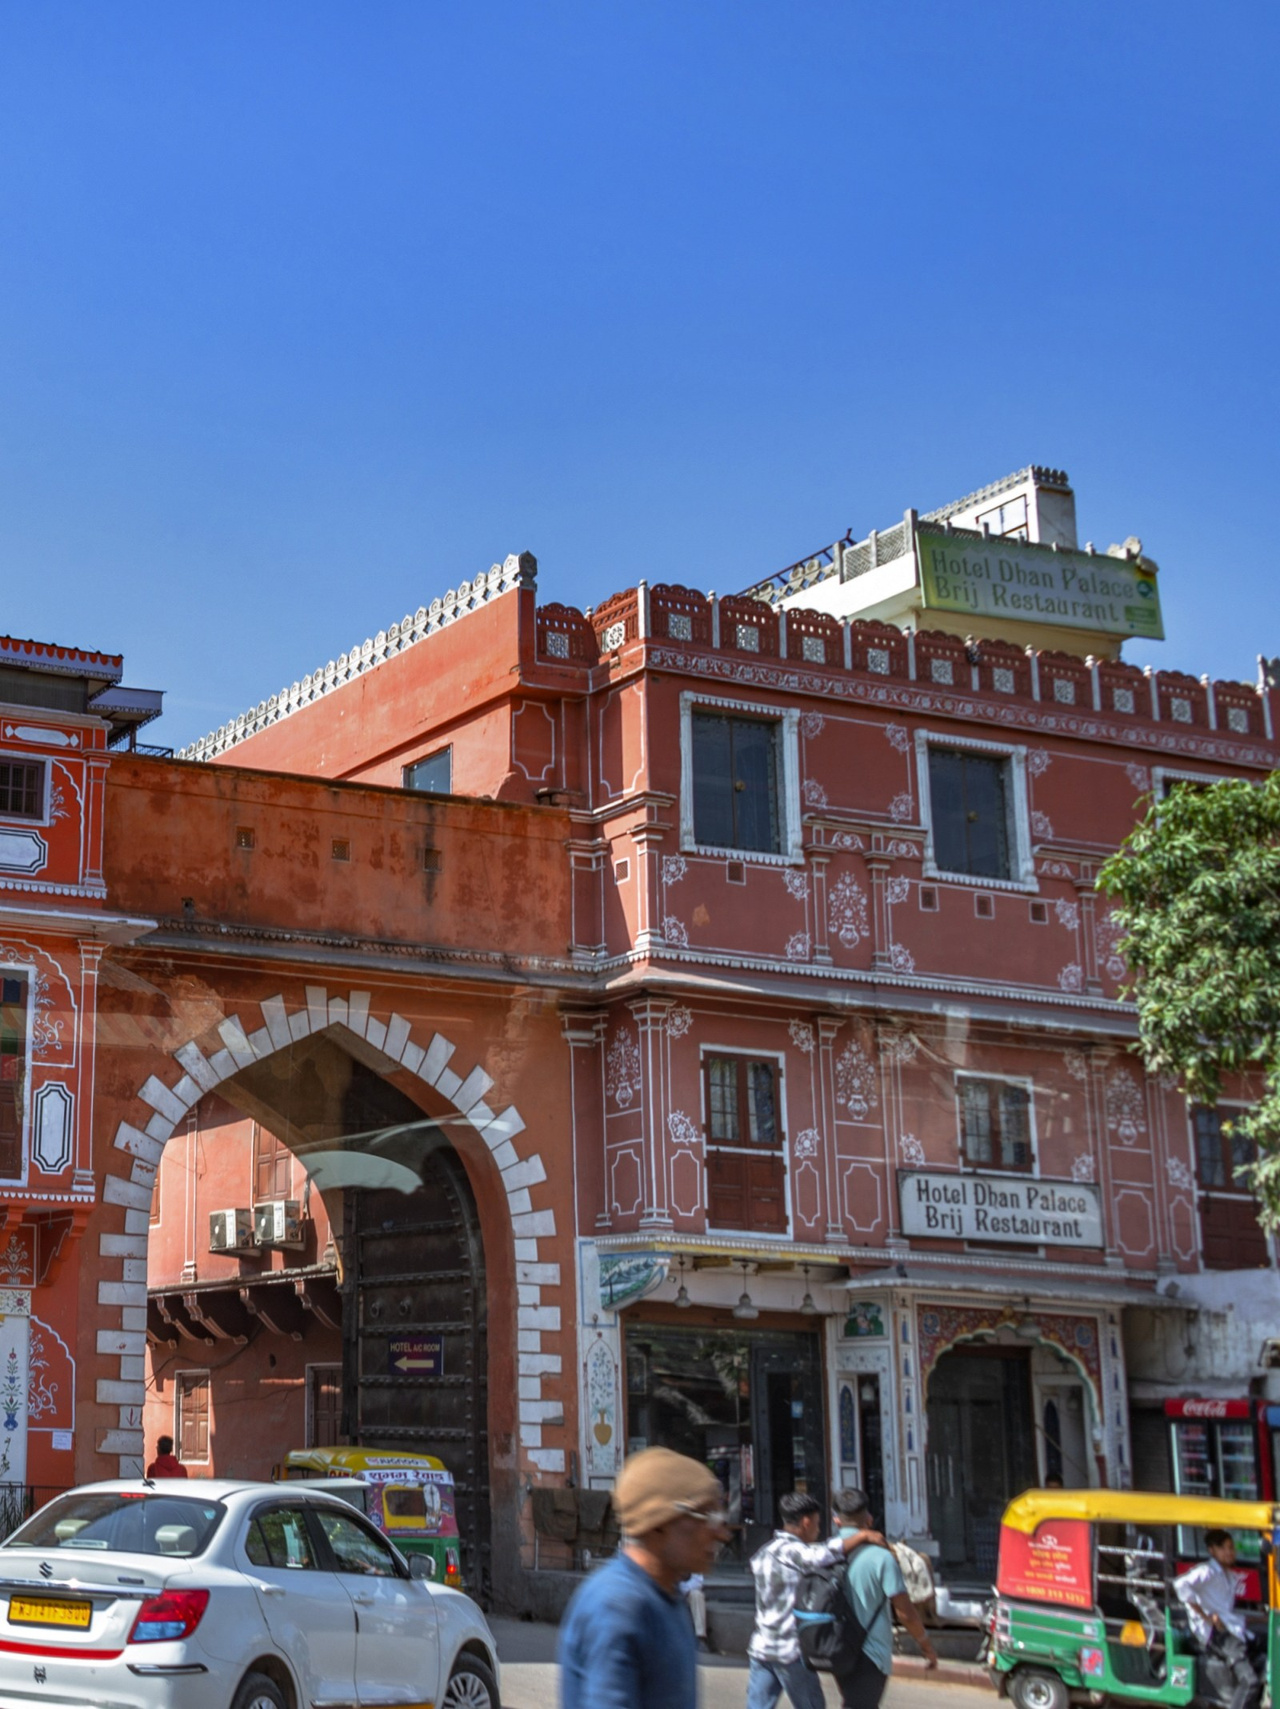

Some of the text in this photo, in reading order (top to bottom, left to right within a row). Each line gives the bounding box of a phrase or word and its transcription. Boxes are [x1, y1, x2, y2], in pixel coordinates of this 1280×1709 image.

[931, 549, 1134, 600] Hotel Dhan Palace
[936, 576, 979, 609] Brij
[992, 584, 1118, 623] Restaurant
[916, 1178, 1086, 1213] Hotel Dhan Palace
[925, 1206, 1082, 1238] Brij Restaurant
[390, 1342, 412, 1353] HOTEL
